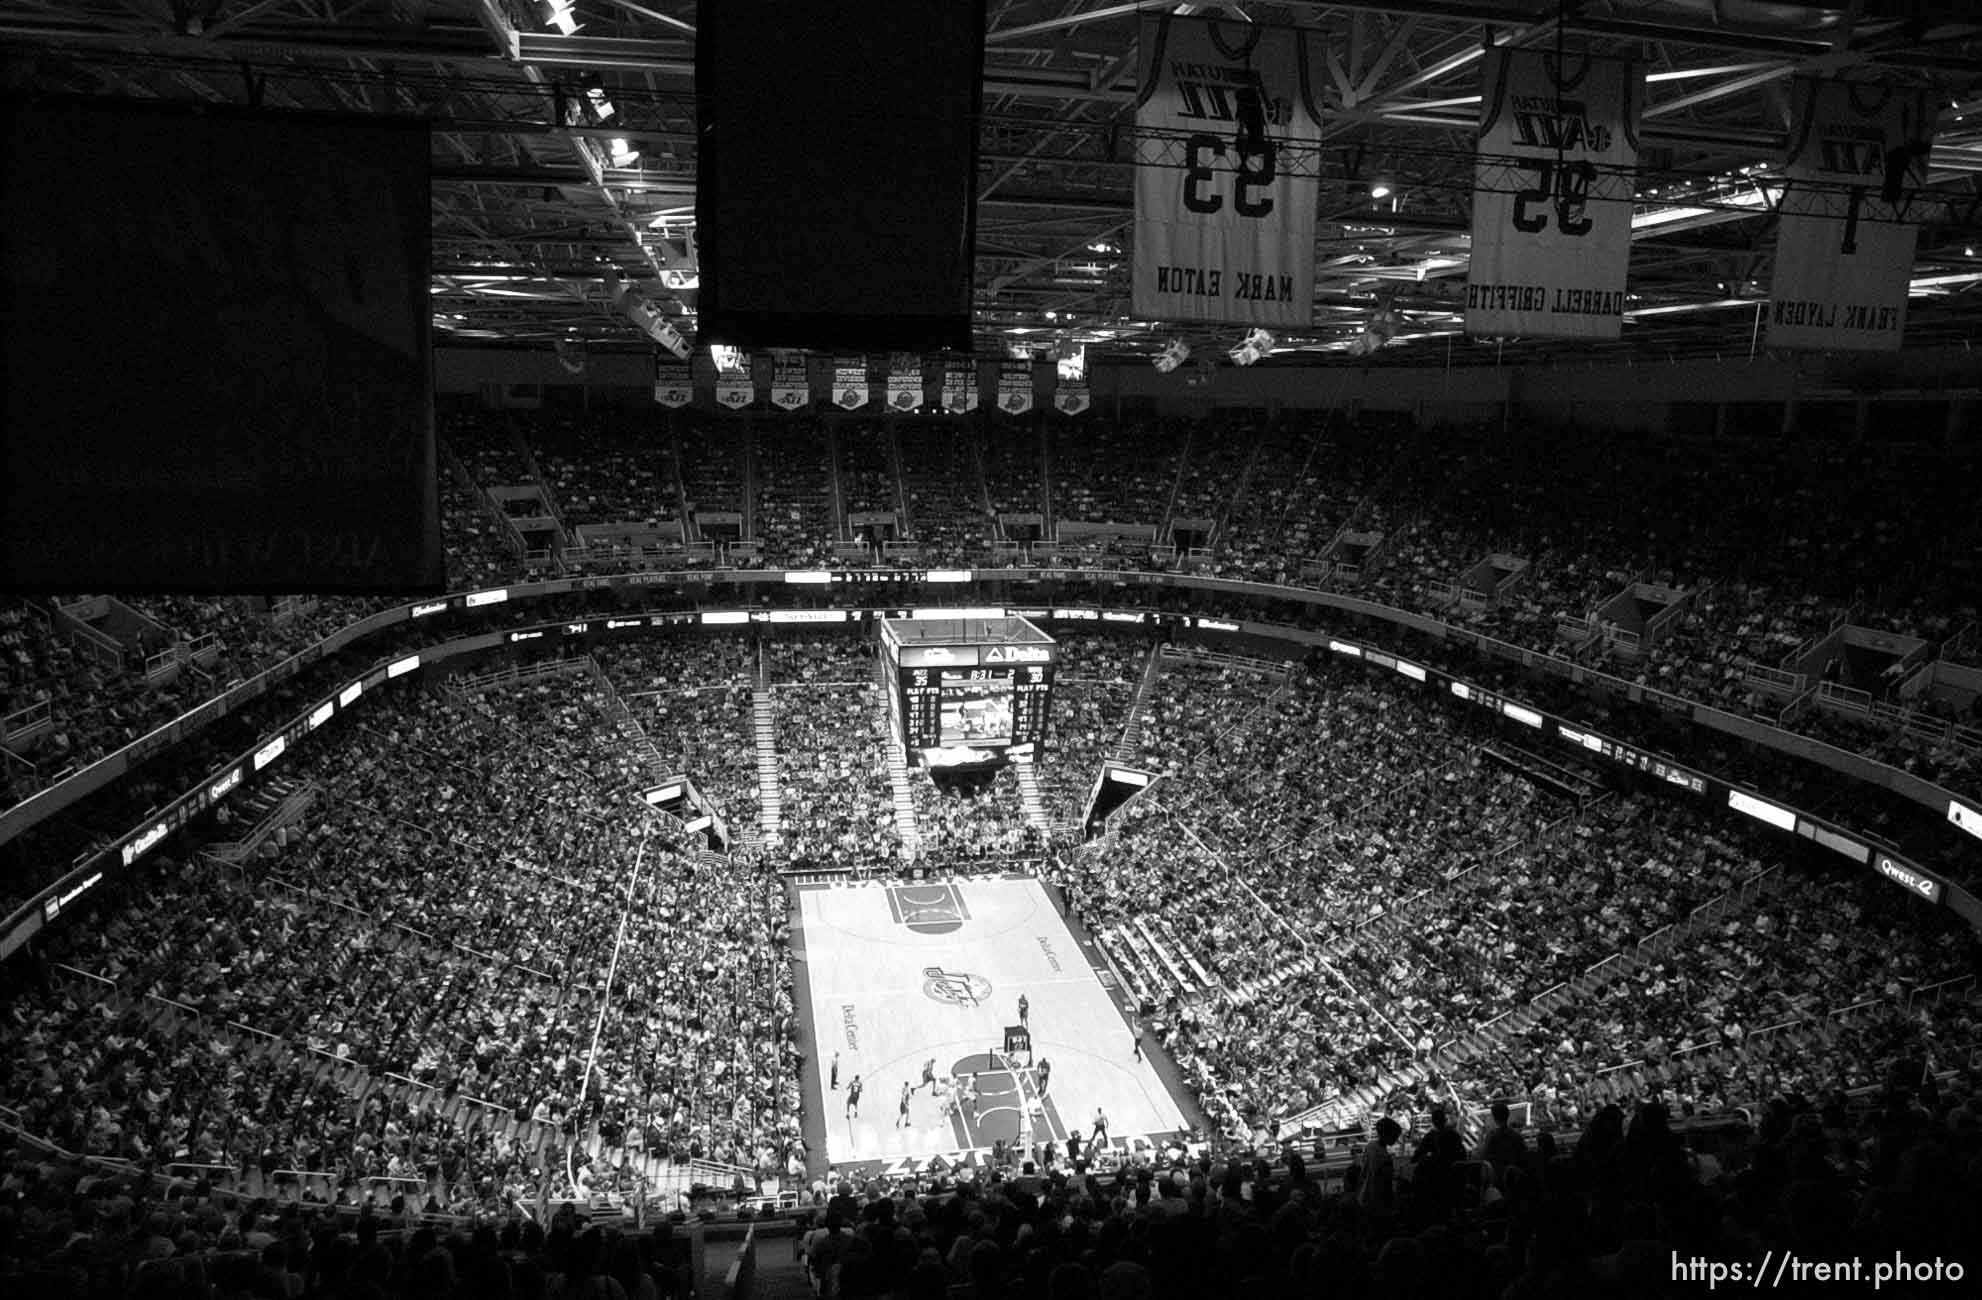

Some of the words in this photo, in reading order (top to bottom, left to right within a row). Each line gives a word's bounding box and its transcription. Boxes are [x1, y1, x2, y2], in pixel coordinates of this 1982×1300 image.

[1004, 646, 1050, 661] Delta
[1882, 859, 1915, 887] Qwest
[842, 1005, 856, 1024] Delta
[845, 1024, 858, 1050] Center
